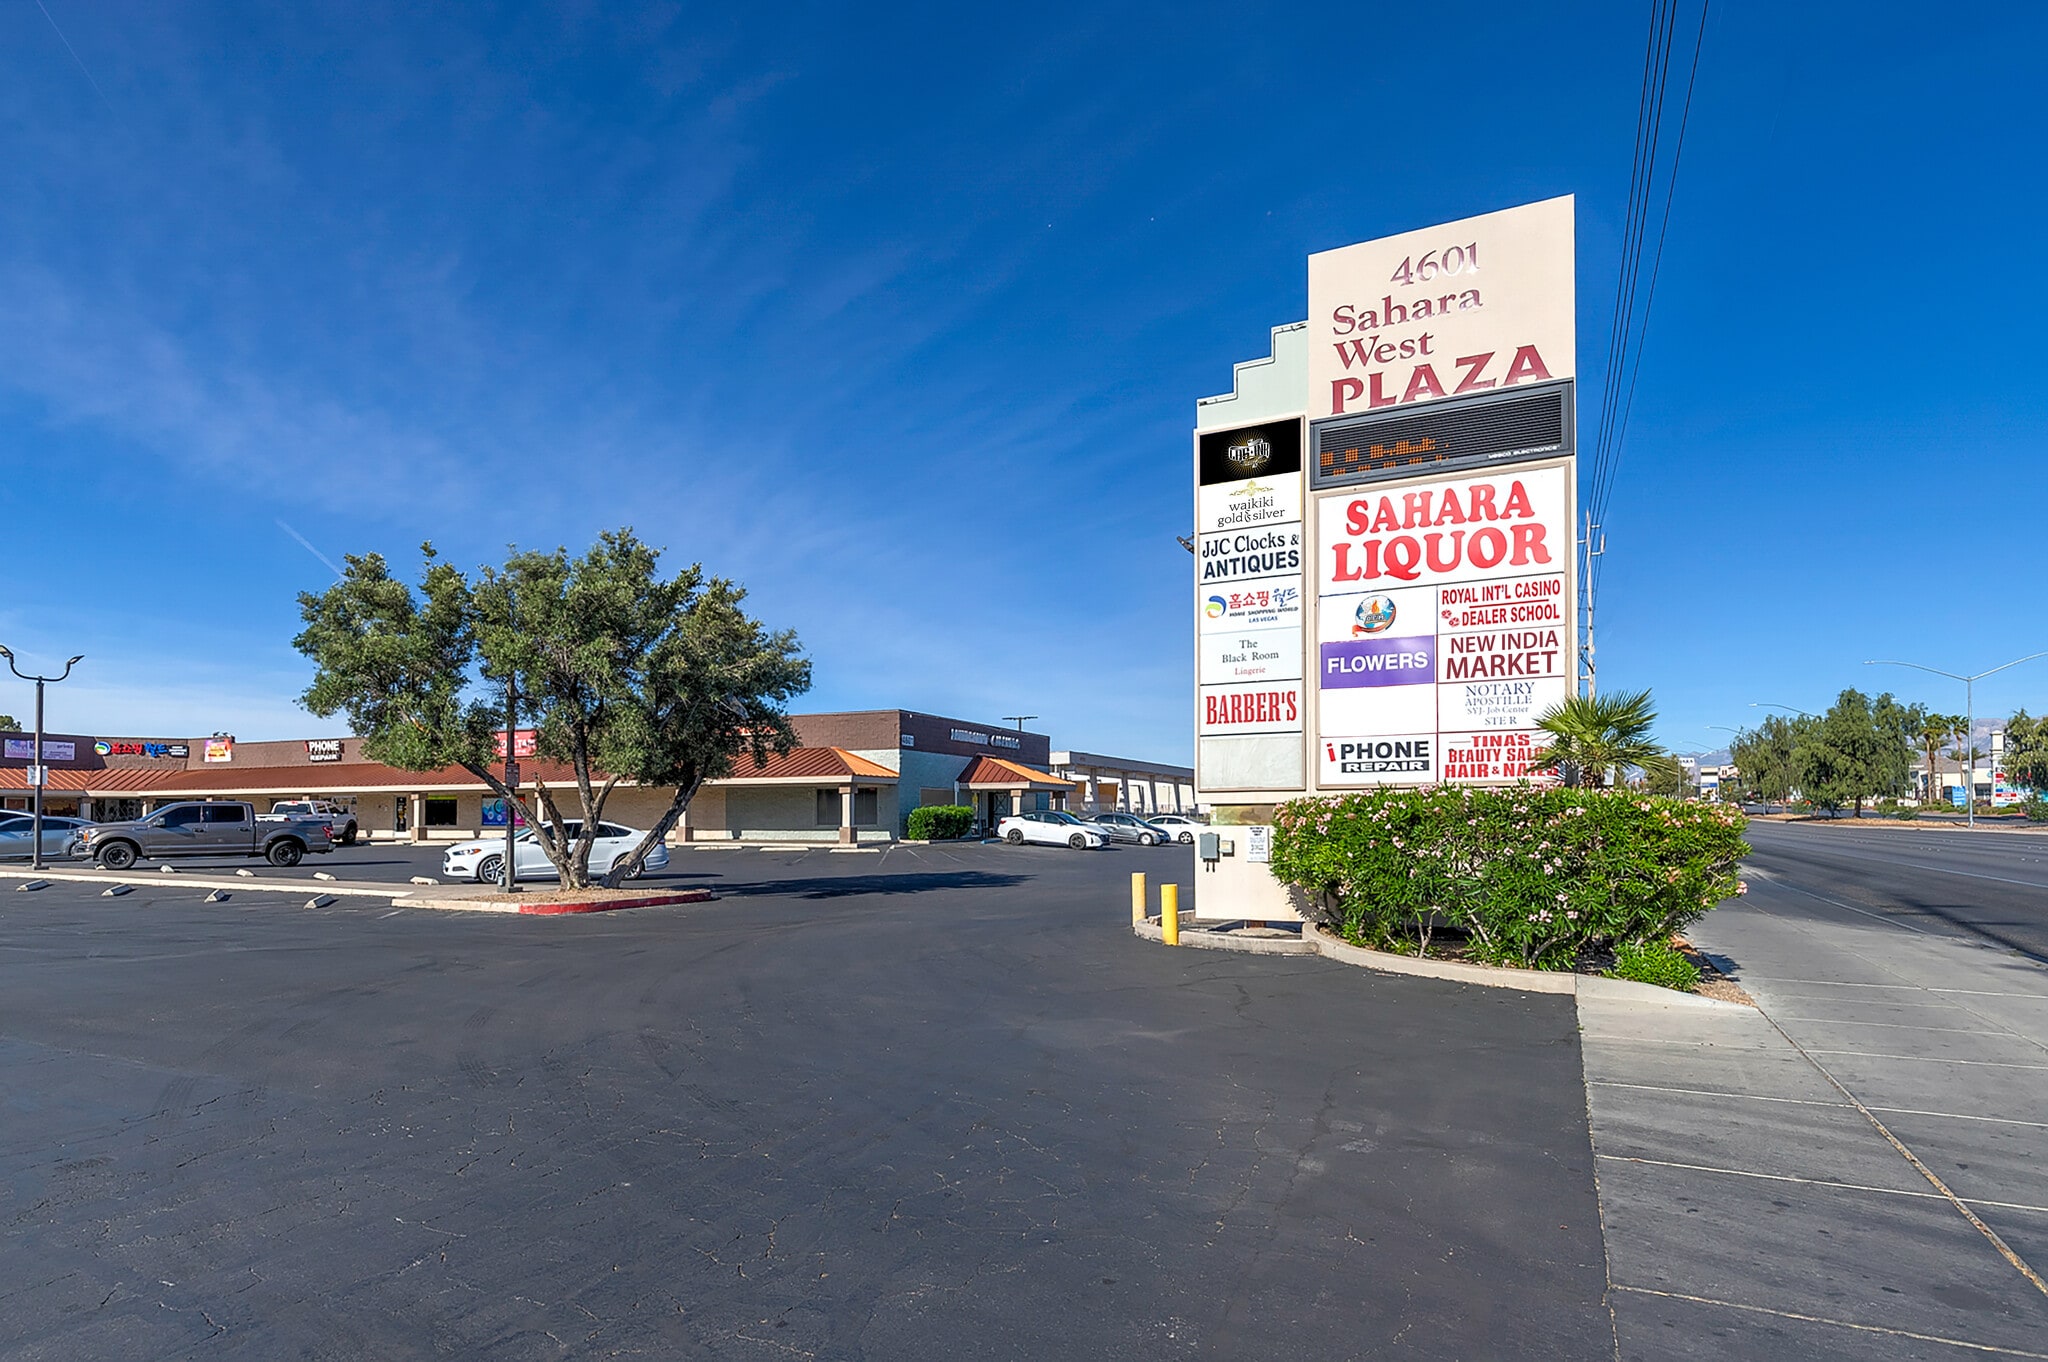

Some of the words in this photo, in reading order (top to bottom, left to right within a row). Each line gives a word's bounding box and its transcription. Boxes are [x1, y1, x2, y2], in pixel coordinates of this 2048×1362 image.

[1390, 242, 1480, 286] 4601
[1333, 288, 1482, 335] Sahara
[1333, 332, 1434, 369] West
[1331, 345, 1553, 414] PLAZA
[1229, 496, 1274, 512] waikiki
[1346, 480, 1535, 536] SAHARA
[1202, 538, 1231, 558] JJC
[1234, 532, 1285, 553] Clocks
[1290, 534, 1299, 546] &
[1331, 523, 1552, 582] LIQUOR
[1203, 550, 1299, 579] ANTIQUES
[1228, 590, 1269, 609] 홈쇼핑
[1272, 588, 1299, 607] 월드
[1441, 587, 1478, 605] ROYAL
[1481, 583, 1511, 602] INT'L
[1515, 579, 1561, 599] CASINO
[1462, 608, 1508, 626] DEALER
[1511, 603, 1560, 622] SCHOOL
[1239, 639, 1258, 649] The
[1450, 634, 1496, 654] NEW
[1501, 630, 1559, 650] INDIA
[1222, 653, 1247, 663] Black
[1251, 651, 1279, 661] Room
[1327, 651, 1428, 674] FLOWERS
[1446, 651, 1558, 679] MARKET
[1234, 666, 1266, 676] Lingerie
[1465, 681, 1535, 697] NOTARY
[1465, 695, 1533, 706] APOSTILLE
[1205, 690, 1297, 725] BARBER'S
[1502, 705, 1529, 713] Center
[309, 740, 339, 751] PHONE
[1471, 733, 1530, 747] TINA'S
[1344, 760, 1425, 772] REPAIR
[1448, 748, 1501, 763] BEAUTY
[1506, 746, 1551, 761] SALO
[1445, 764, 1489, 778] HAIR
[1491, 766, 1500, 775] &
